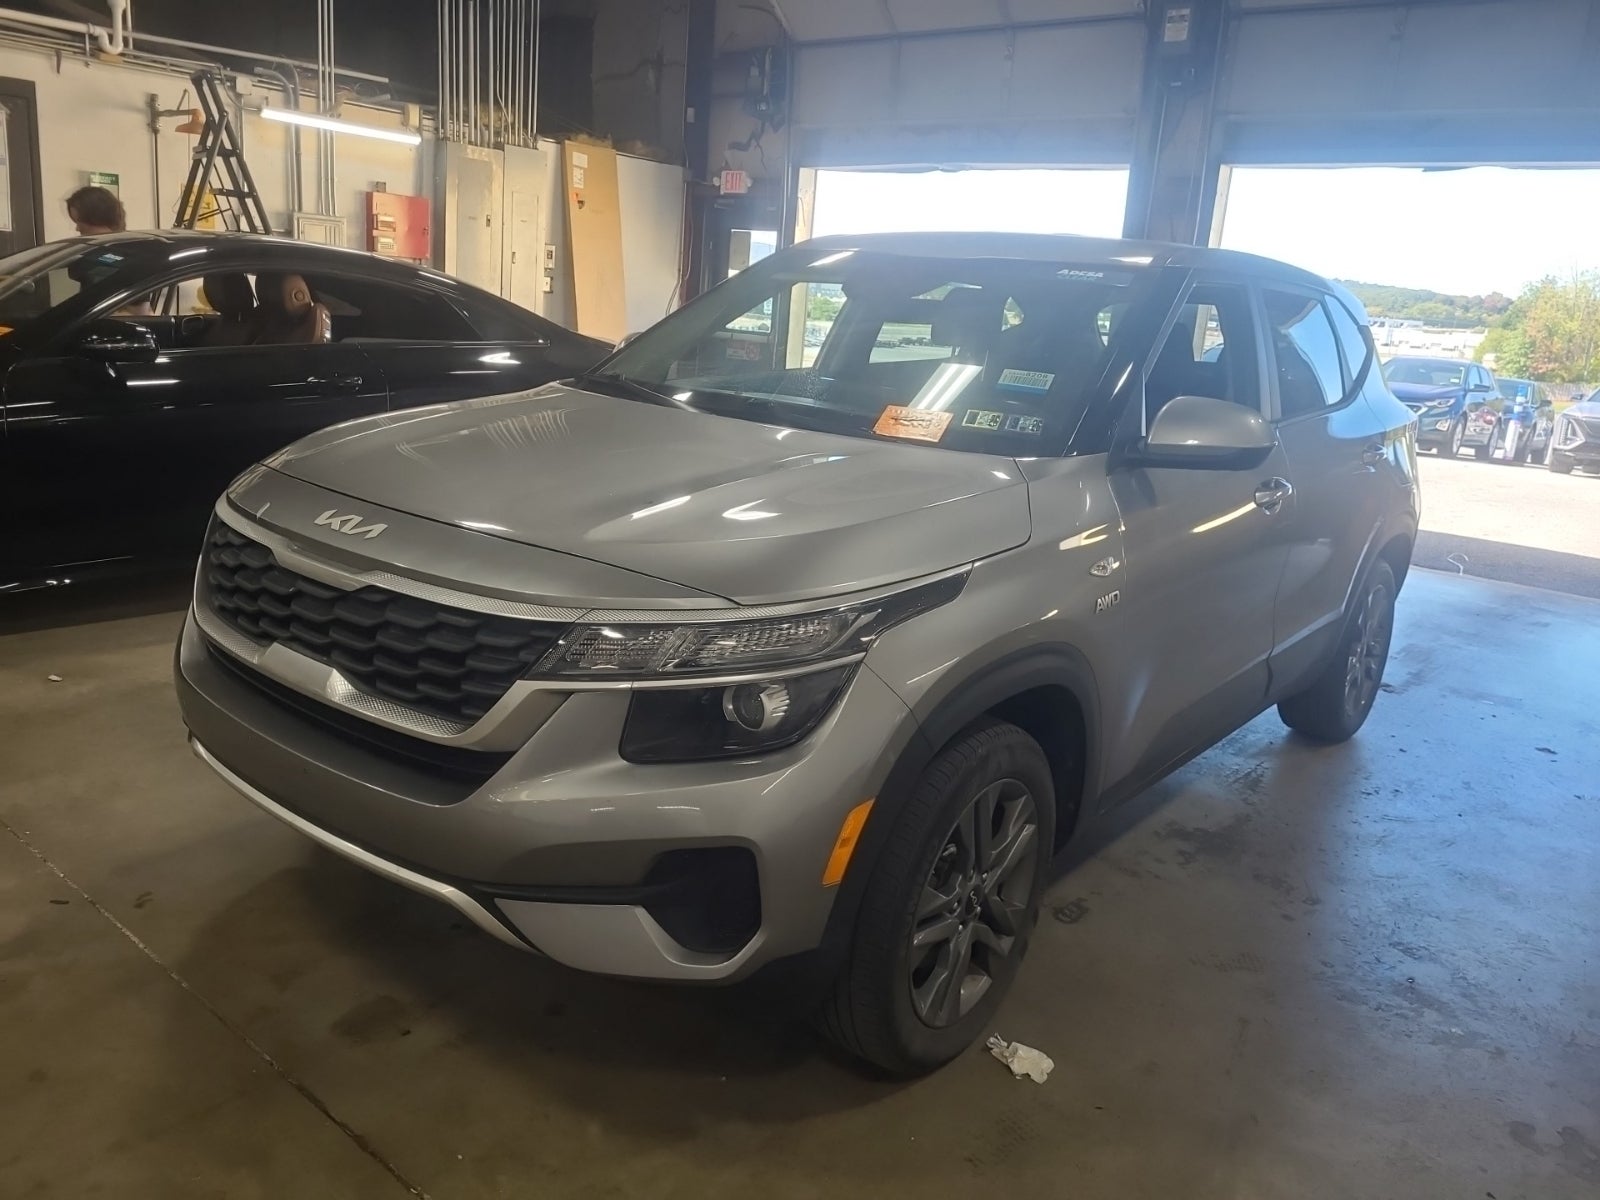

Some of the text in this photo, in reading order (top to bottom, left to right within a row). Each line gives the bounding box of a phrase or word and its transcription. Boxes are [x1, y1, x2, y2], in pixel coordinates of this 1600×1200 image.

[726, 172, 744, 191] EXIT
[313, 509, 388, 540] KIA
[1095, 590, 1121, 614] AWD
